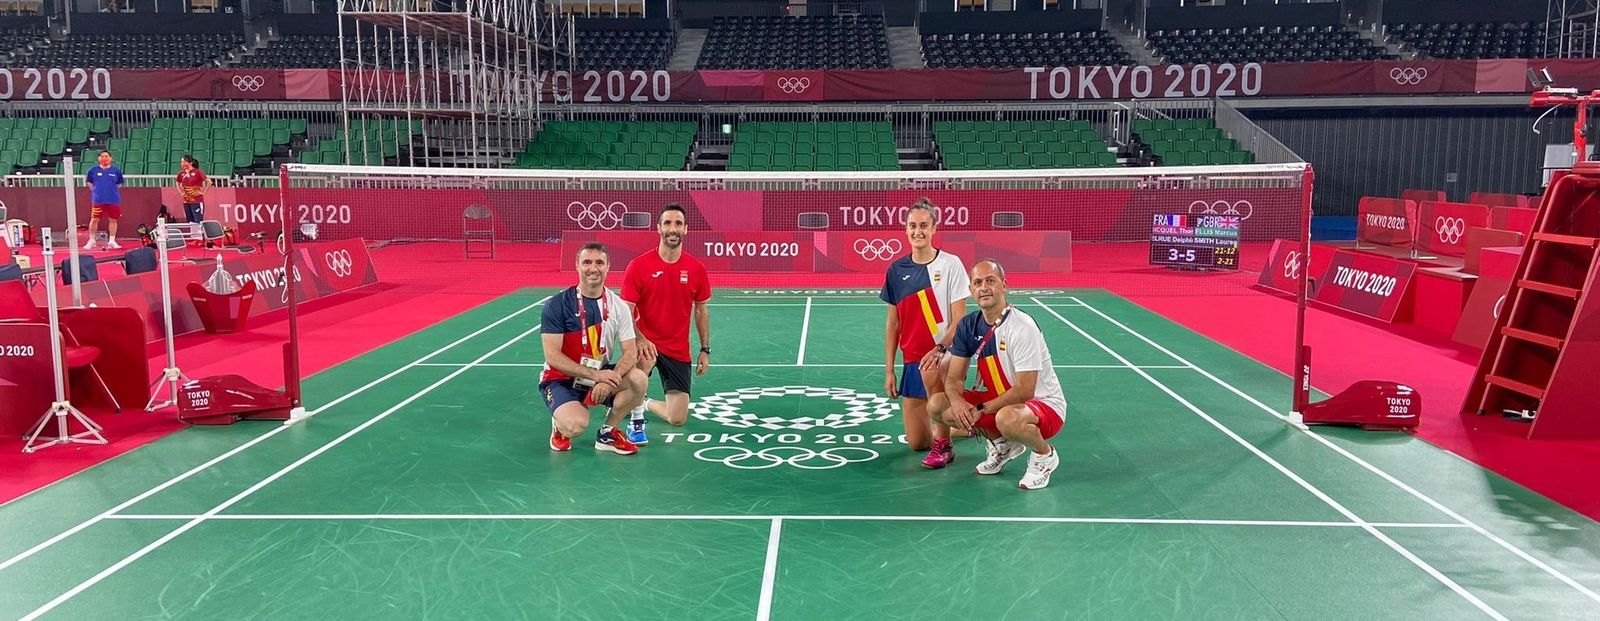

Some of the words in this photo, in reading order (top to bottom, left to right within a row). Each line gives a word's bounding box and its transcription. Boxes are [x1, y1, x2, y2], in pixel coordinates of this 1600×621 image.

[24, 68, 111, 99] 2020
[583, 69, 671, 102] 2020
[1024, 65, 1153, 100] TOKYO
[1164, 62, 1262, 98] 2020
[298, 204, 350, 224] 2020
[1153, 214, 1168, 226] FRA
[1366, 213, 1387, 228] TOKYO
[1387, 216, 1405, 230] 2020
[704, 242, 756, 257] TOKYO
[760, 242, 799, 257] 2020
[1168, 248, 1195, 262] 3-5
[1215, 247, 1236, 255] 21-12
[1217, 257, 1234, 265] 2-21
[1333, 266, 1367, 290] TOKYO
[1365, 273, 1397, 297] 2020
[6, 345, 34, 356] 2020
[187, 390, 210, 399] TOKYO
[191, 398, 209, 406] 2020
[1386, 397, 1411, 406] TOKYO
[1389, 405, 1408, 414] 2020
[660, 433, 802, 444] TOKYO
